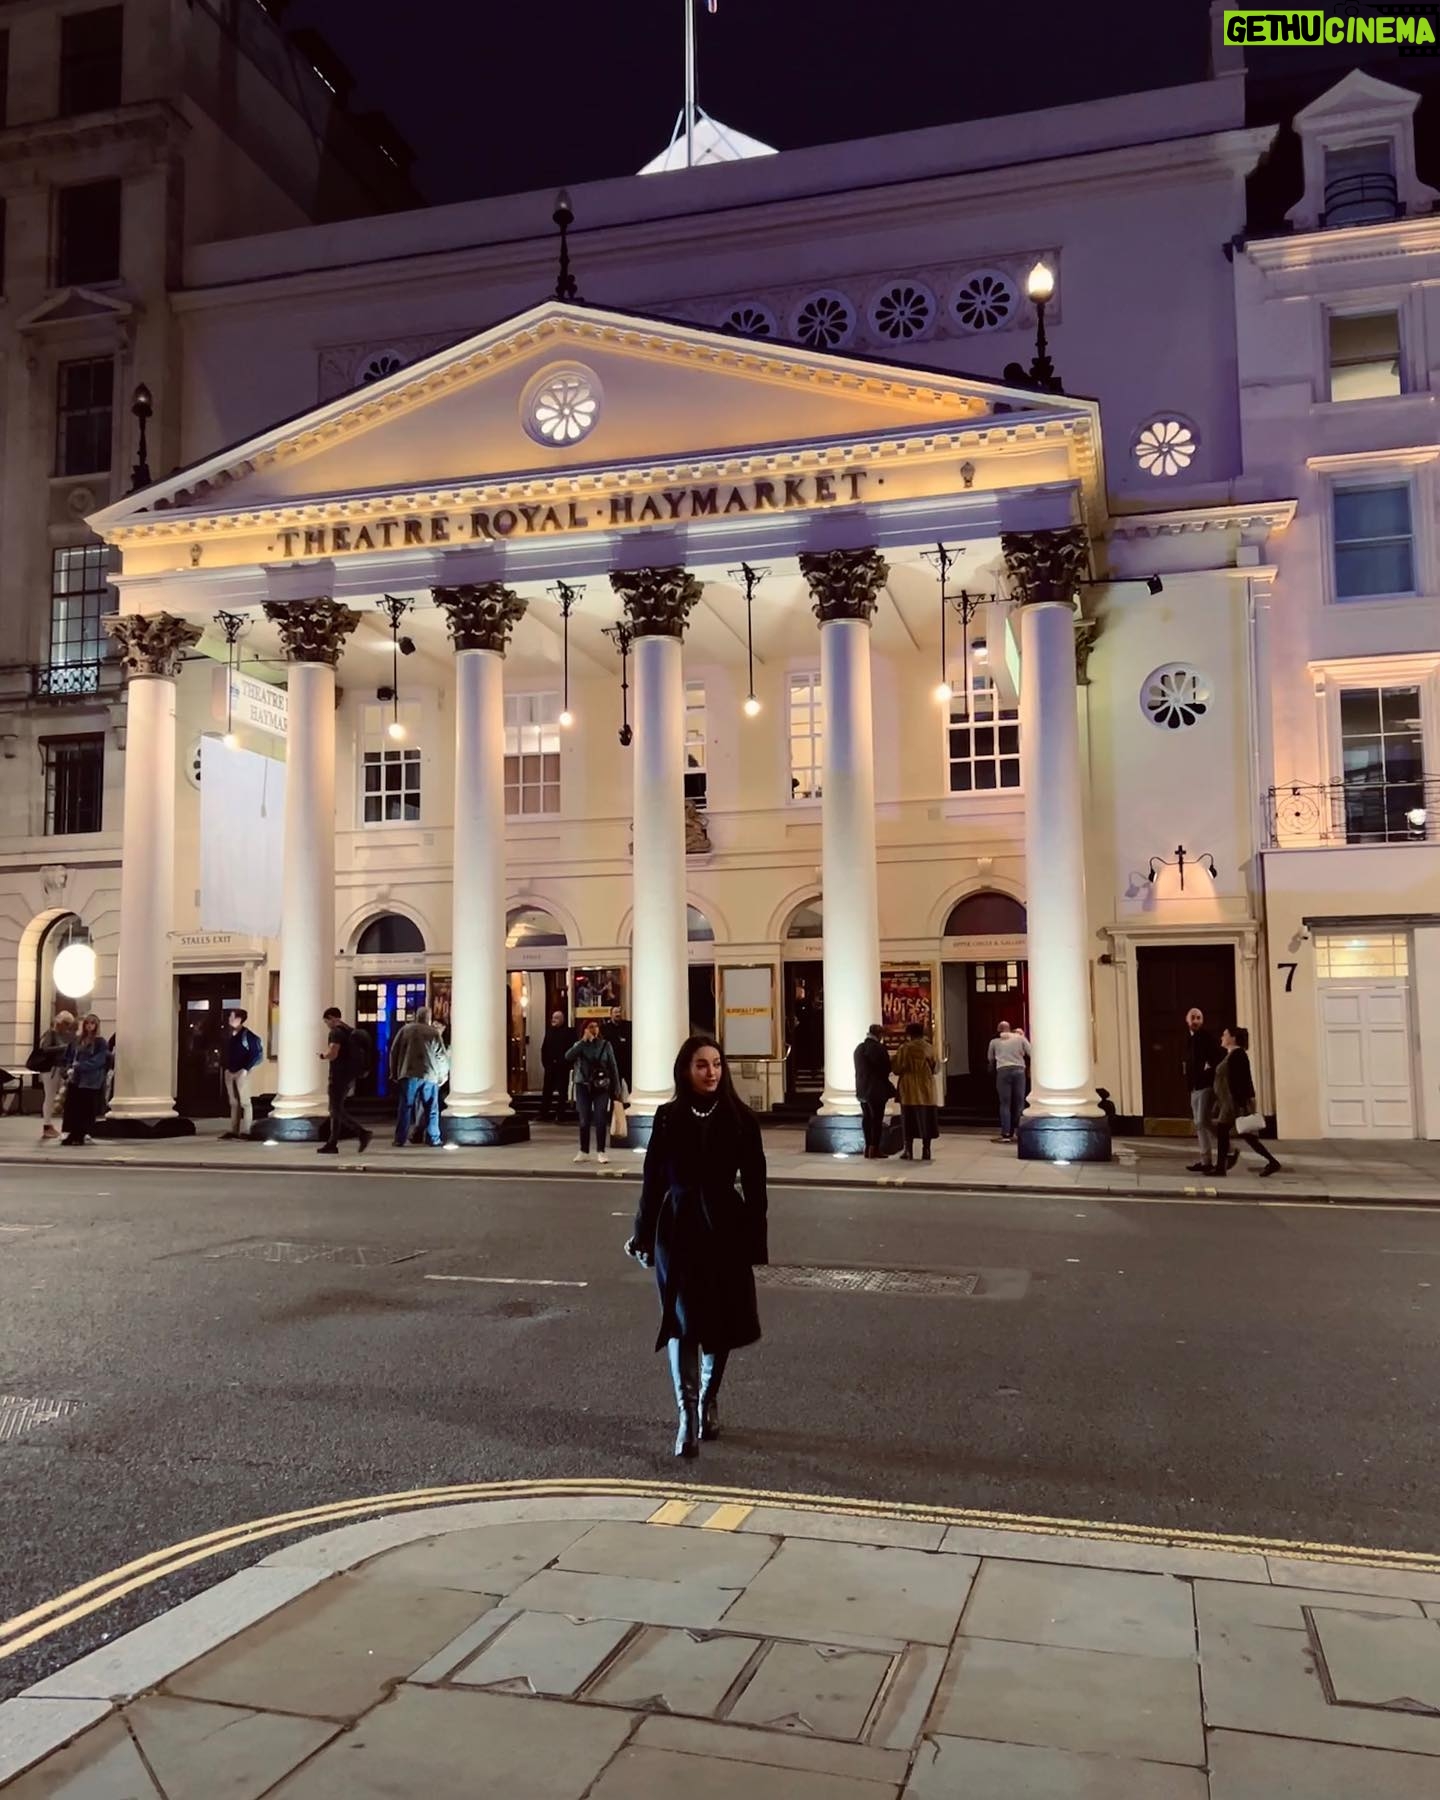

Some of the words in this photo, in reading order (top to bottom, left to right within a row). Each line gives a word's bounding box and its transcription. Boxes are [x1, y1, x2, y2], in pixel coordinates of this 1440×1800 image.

[277, 515, 450, 558] THEATRE
[470, 502, 589, 540] ROYAL
[609, 471, 868, 524] HAYMARKET
[242, 680, 285, 711] THEATRE
[181, 935, 211, 945] STALLS
[213, 935, 232, 944] EXIT
[1277, 962, 1299, 993] 7
